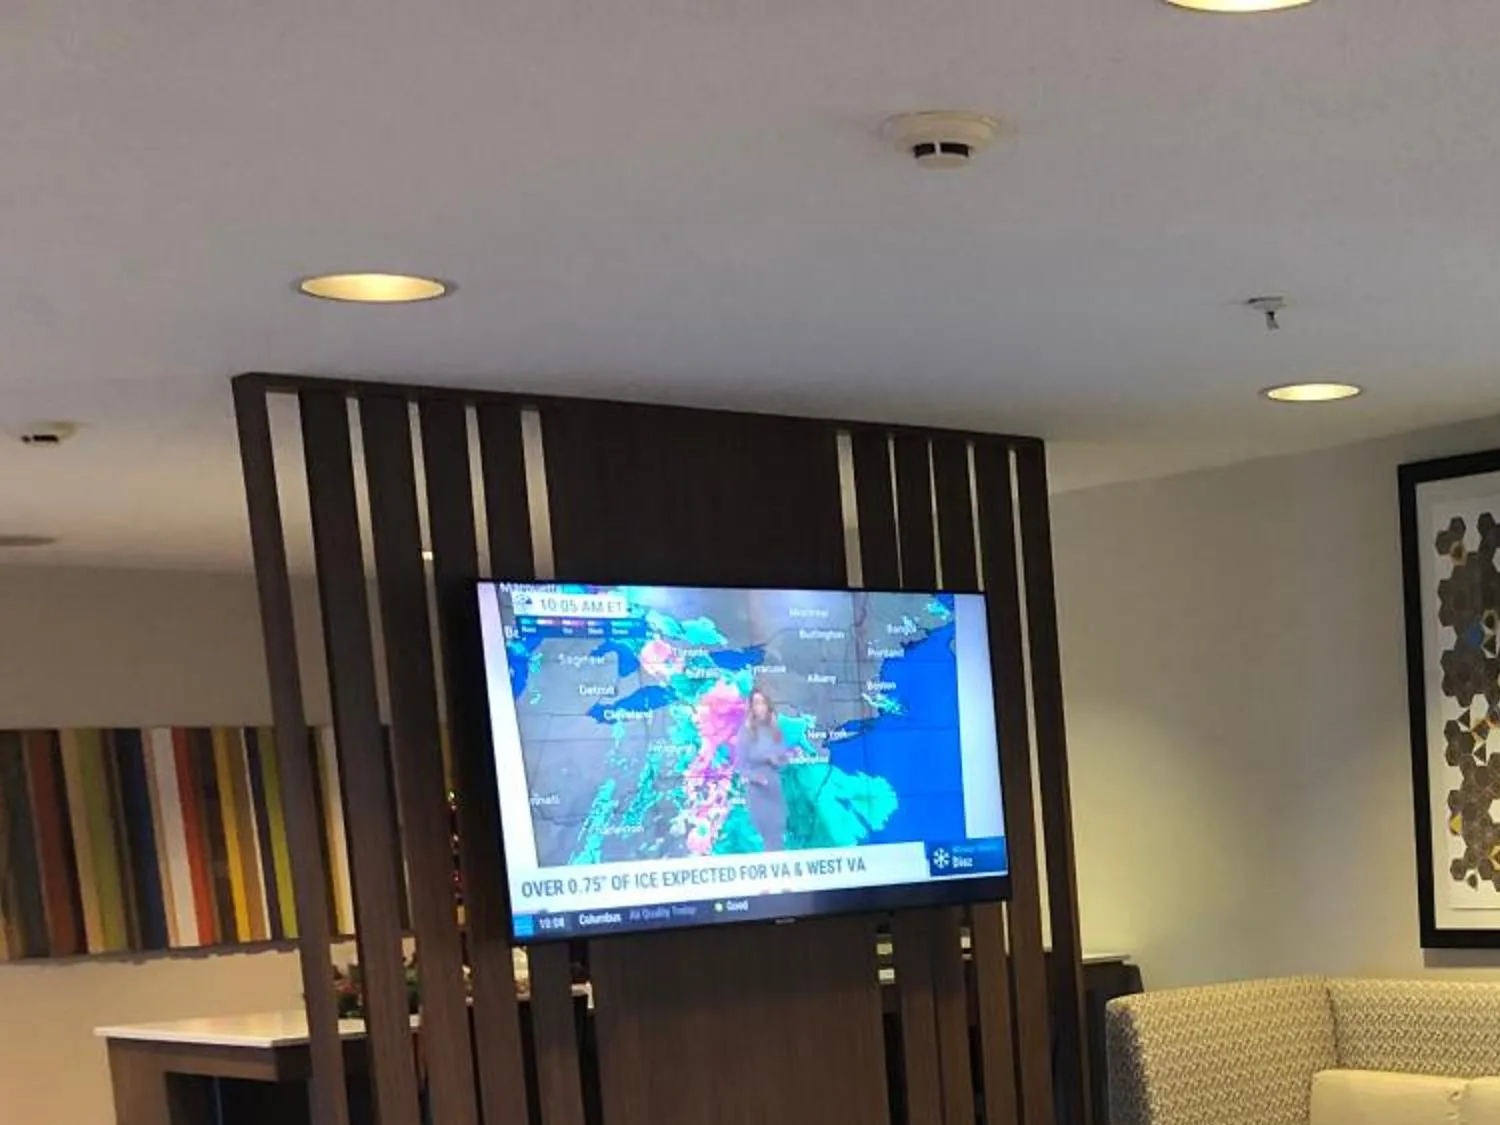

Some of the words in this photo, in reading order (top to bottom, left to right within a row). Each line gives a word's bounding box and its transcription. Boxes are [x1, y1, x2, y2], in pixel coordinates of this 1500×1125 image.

[581, 600, 604, 613] AM
[607, 600, 624, 613] ET
[807, 672, 837, 685] Albany
[578, 684, 616, 696] Detroit
[603, 708, 655, 722] Cleveland
[806, 728, 828, 739] New
[521, 879, 564, 898] OVER
[611, 874, 631, 891] OF
[635, 872, 658, 888] ICE
[662, 867, 737, 886] EXPECTED
[740, 863, 768, 880] FOR
[770, 862, 791, 877] VA
[793, 861, 803, 876] &
[805, 858, 843, 875] WEST
[847, 857, 867, 872] VA
[578, 912, 622, 925] Columbus
[726, 900, 750, 913] Good
